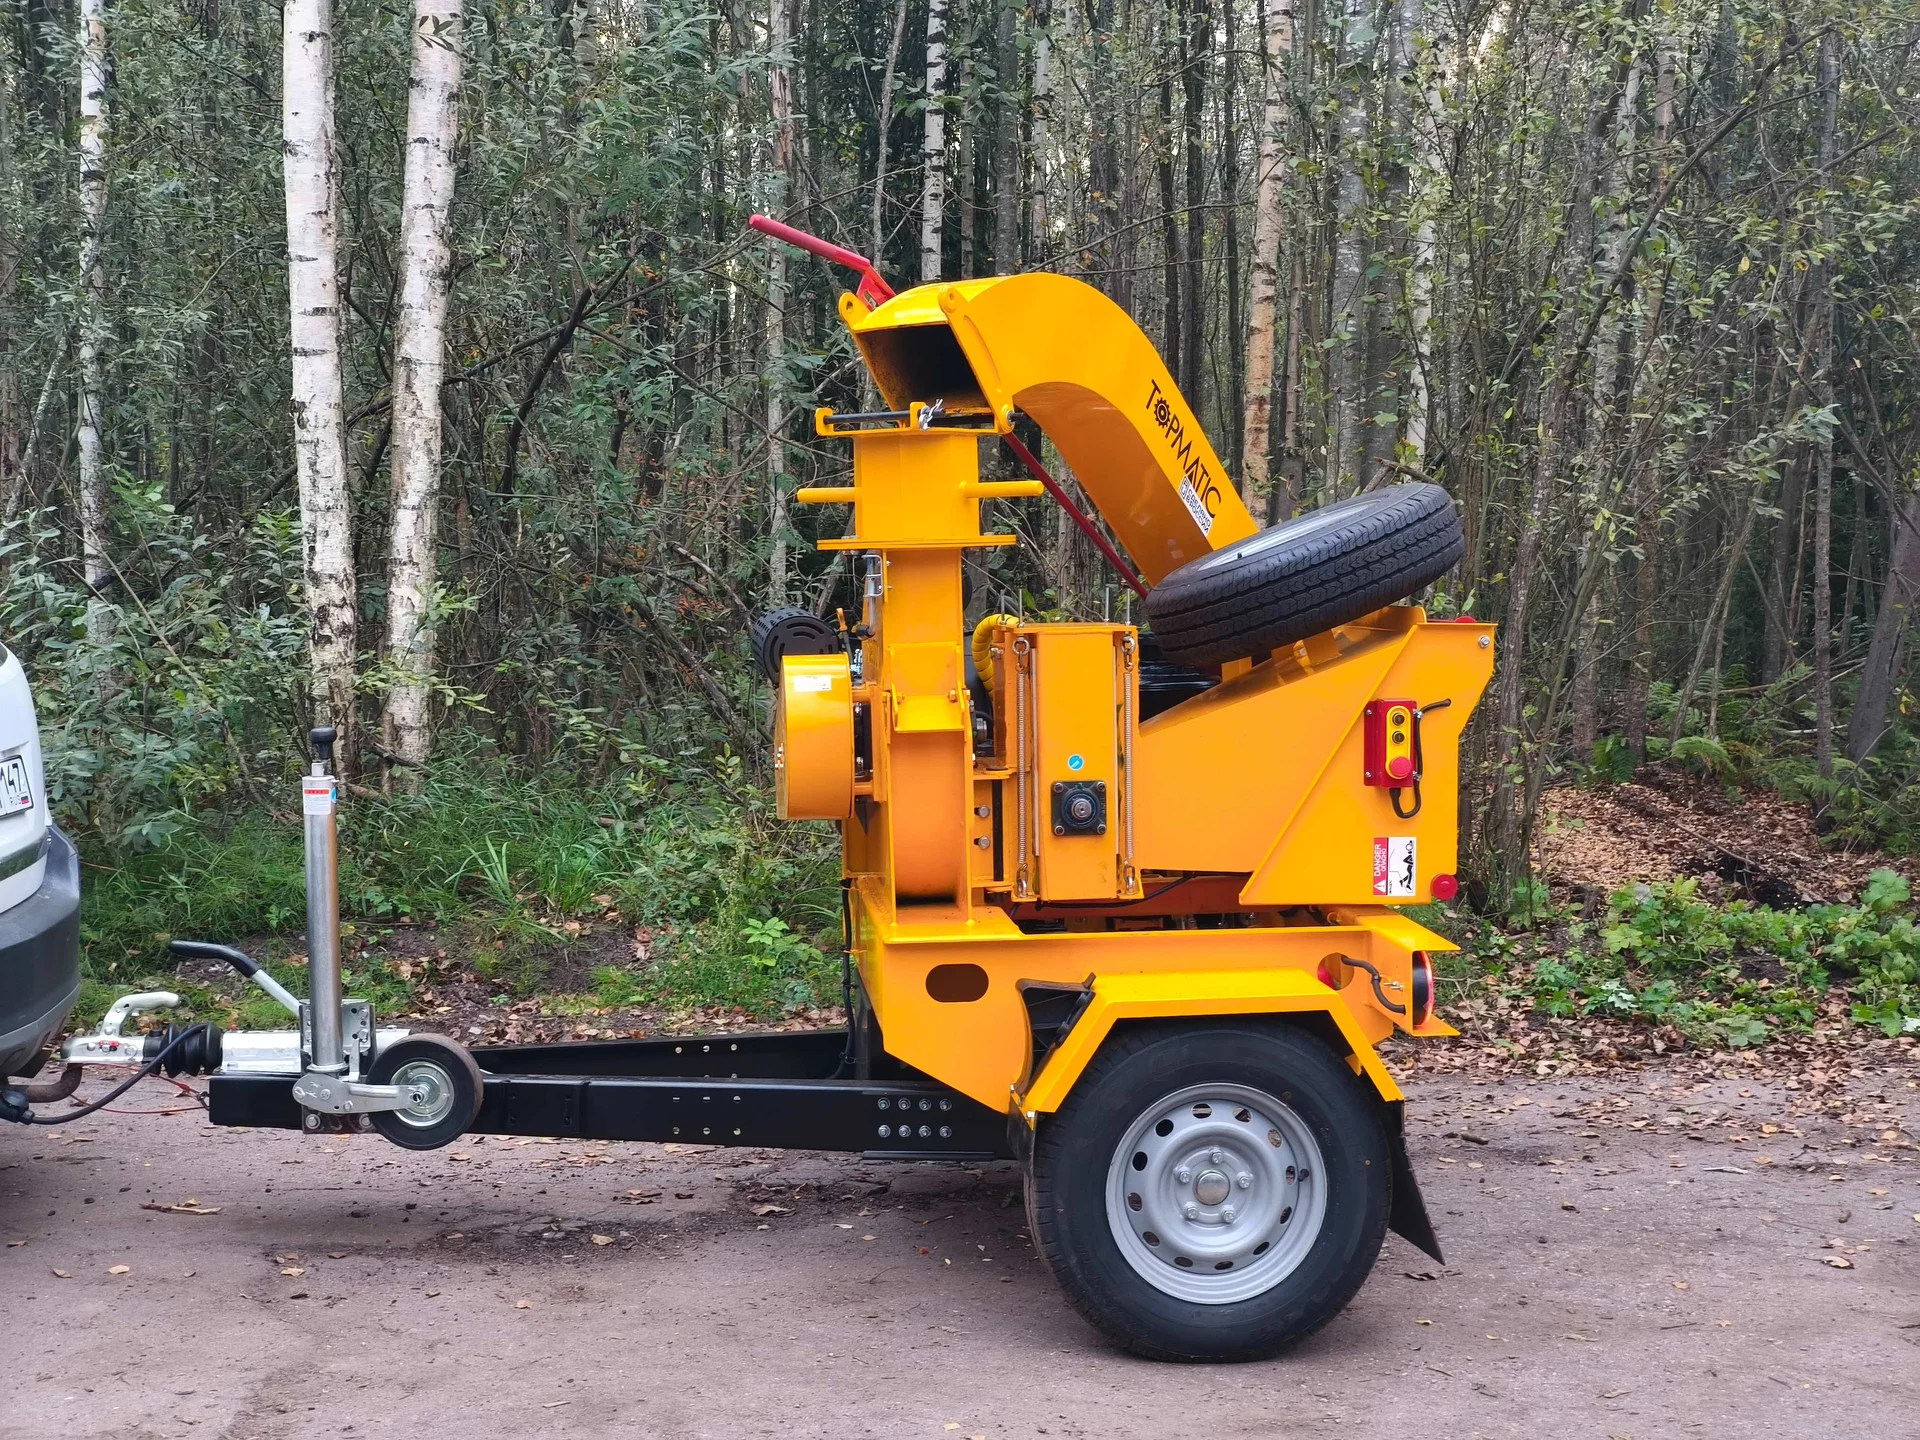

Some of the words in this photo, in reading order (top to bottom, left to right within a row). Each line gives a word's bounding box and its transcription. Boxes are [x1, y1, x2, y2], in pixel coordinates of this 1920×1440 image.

[1145, 378, 1222, 519] TOPMATIC
[1187, 487, 1212, 529] СДЕЛАНО
[1374, 843, 1382, 877] DANGER
